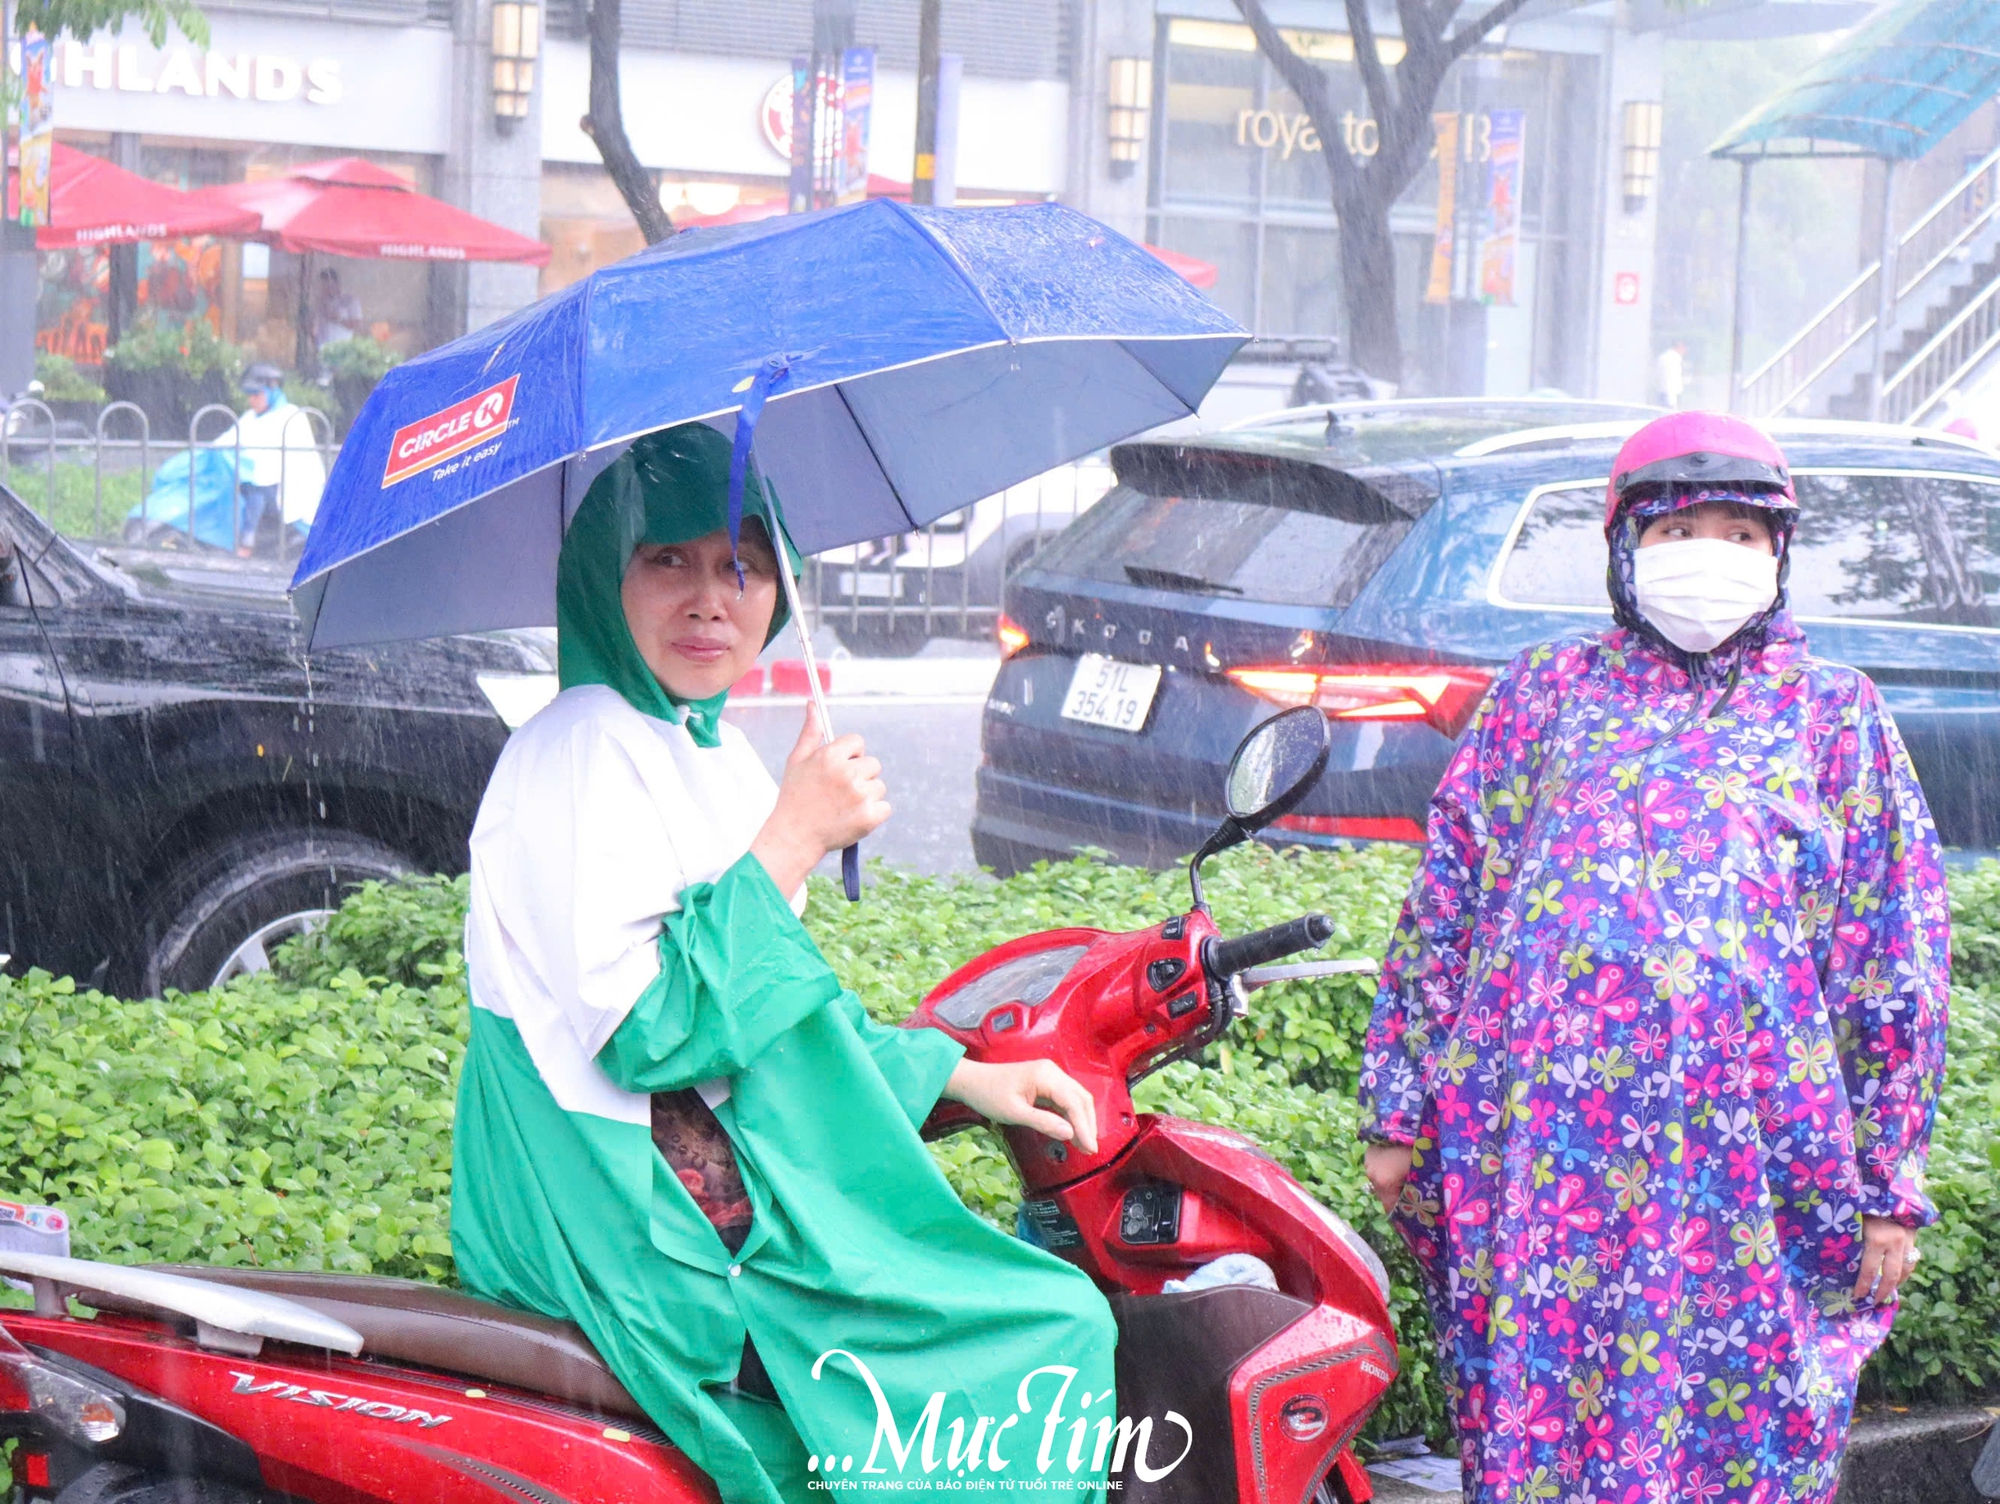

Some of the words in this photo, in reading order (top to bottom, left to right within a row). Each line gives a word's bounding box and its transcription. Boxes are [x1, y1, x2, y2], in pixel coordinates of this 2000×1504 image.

[1237, 109, 1323, 161] roya
[399, 411, 472, 459] CIRCLE
[475, 392, 504, 428] K
[432, 462, 459, 482] Take
[461, 455, 472, 468] it
[474, 441, 502, 463] easy
[1095, 662, 1129, 693] 51L
[1071, 691, 1138, 726] 354.19
[1360, 1360, 1390, 1383] HONDA
[229, 1370, 453, 1429] VISION
